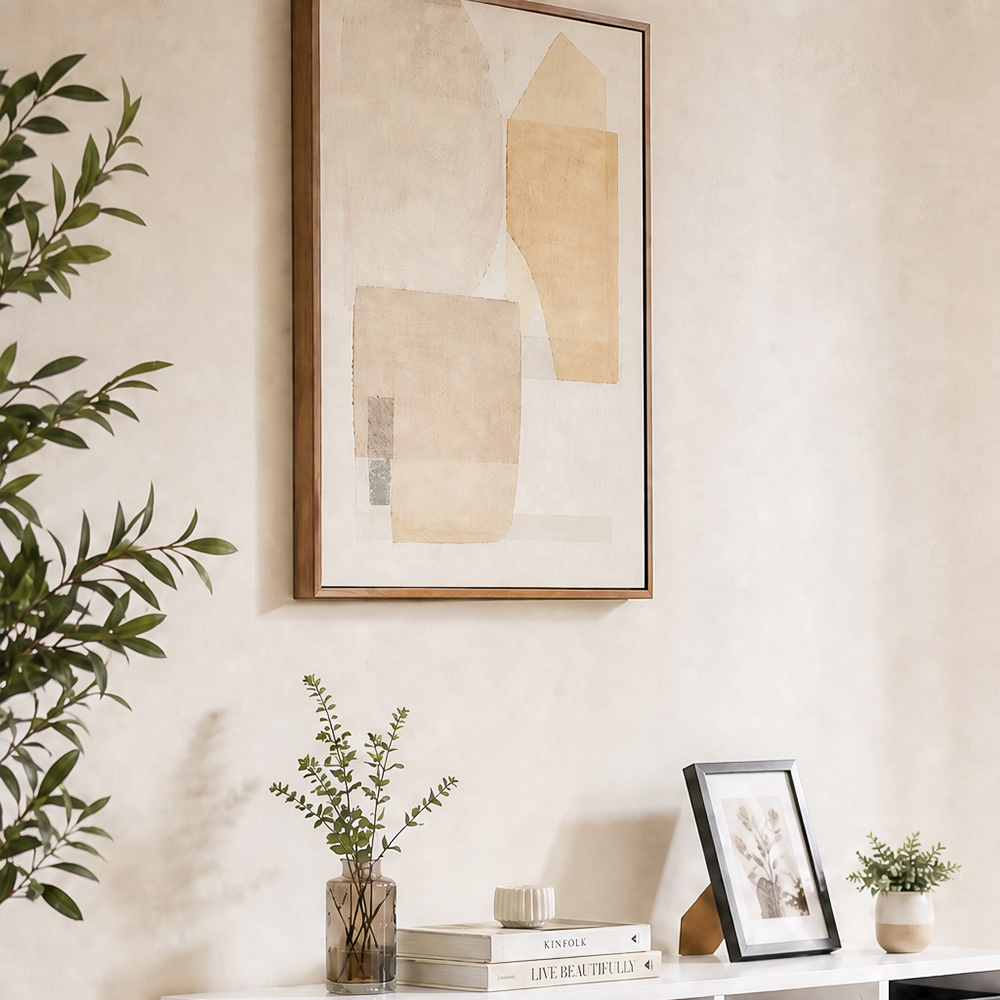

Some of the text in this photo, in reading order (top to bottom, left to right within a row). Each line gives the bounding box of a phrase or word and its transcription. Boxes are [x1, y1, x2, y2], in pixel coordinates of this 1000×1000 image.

[544, 937, 587, 950] KINFOLK
[531, 959, 636, 981] LIVE BEAUTIFULLY
